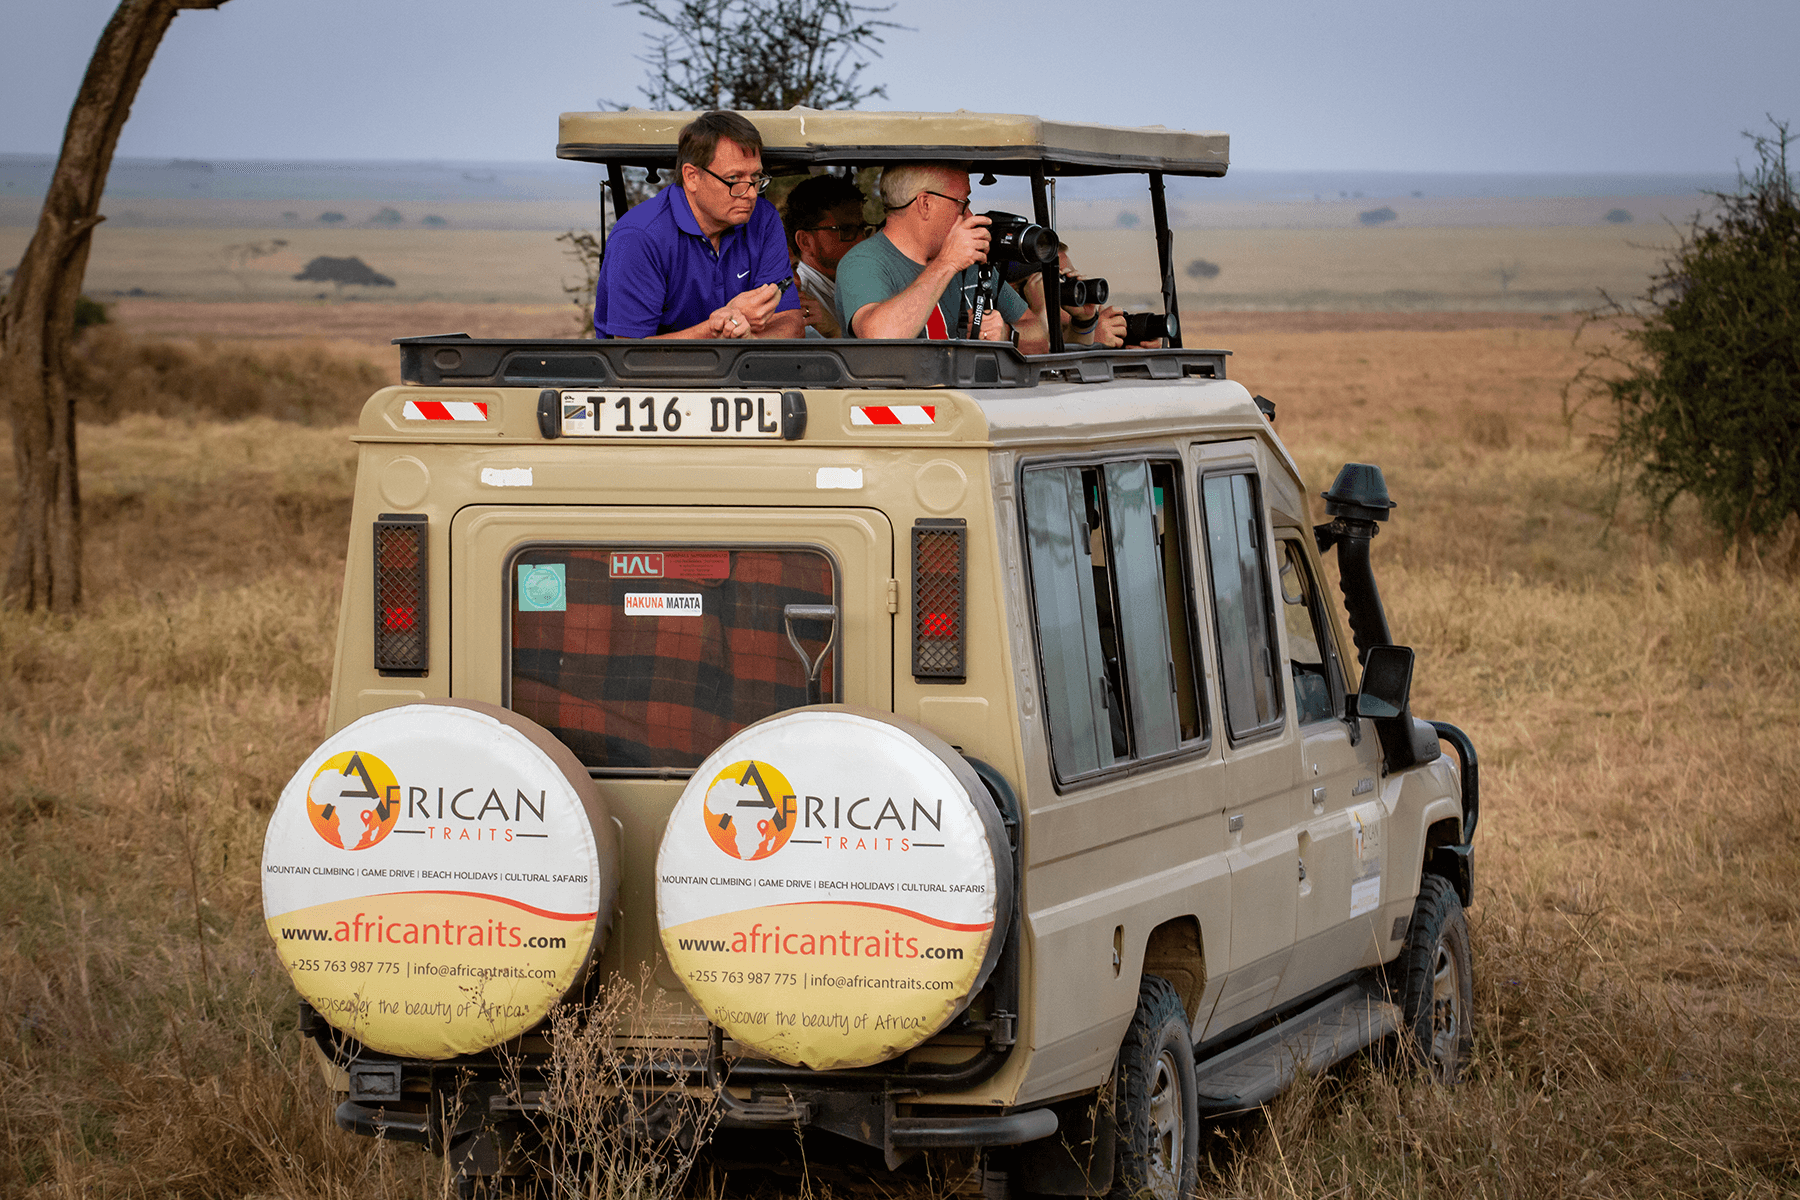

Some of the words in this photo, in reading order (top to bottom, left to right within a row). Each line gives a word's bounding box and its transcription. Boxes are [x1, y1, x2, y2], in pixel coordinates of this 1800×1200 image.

[587, 396, 606, 431] T
[615, 396, 683, 432] 116
[710, 397, 778, 433] DPL
[613, 556, 659, 574] HAL
[626, 597, 664, 608] HAKUNA
[666, 597, 701, 609] MATATA
[321, 751, 546, 823] AFRICAN
[718, 761, 942, 832] AFRICAN
[428, 826, 514, 842] TRAITS
[824, 836, 910, 852] TRAITS
[266, 865, 311, 875] MOUNTAIN
[312, 867, 355, 877] CLIMBING
[361, 868, 387, 877] GAME
[389, 869, 415, 879] DRIVE
[421, 870, 452, 880] BEACH
[453, 871, 498, 881] HOLIDAYS
[504, 873, 550, 883] CULTURAL
[552, 874, 588, 884] SAFARIS
[662, 875, 708, 886] MOUNTAIN
[710, 877, 751, 887] CLIMBING
[759, 878, 784, 888] GAME
[786, 879, 812, 889] DRIVE
[818, 880, 849, 890] BEACH
[850, 881, 895, 891] HOLIDAYS
[901, 883, 947, 893] CULTURAL
[949, 884, 985, 893] SAFARIS
[281, 912, 567, 949] www.africantraits.com
[678, 923, 964, 960] www.africantraits.com
[290, 958, 320, 972] +255
[324, 959, 347, 973] 763
[350, 960, 373, 974] 987
[376, 961, 400, 975] 775
[413, 961, 556, 980] info@africantraits.com
[688, 969, 718, 983] +255
[721, 971, 744, 984] 763
[747, 972, 771, 985] 987
[774, 973, 797, 986] 775
[811, 973, 954, 990] info@africantraits.com
[378, 999, 399, 1015] the
[404, 1000, 452, 1024] beauty
[456, 1002, 472, 1017] of
[776, 1010, 797, 1026] the
[801, 1011, 849, 1036] beauty
[853, 1013, 869, 1029] of
